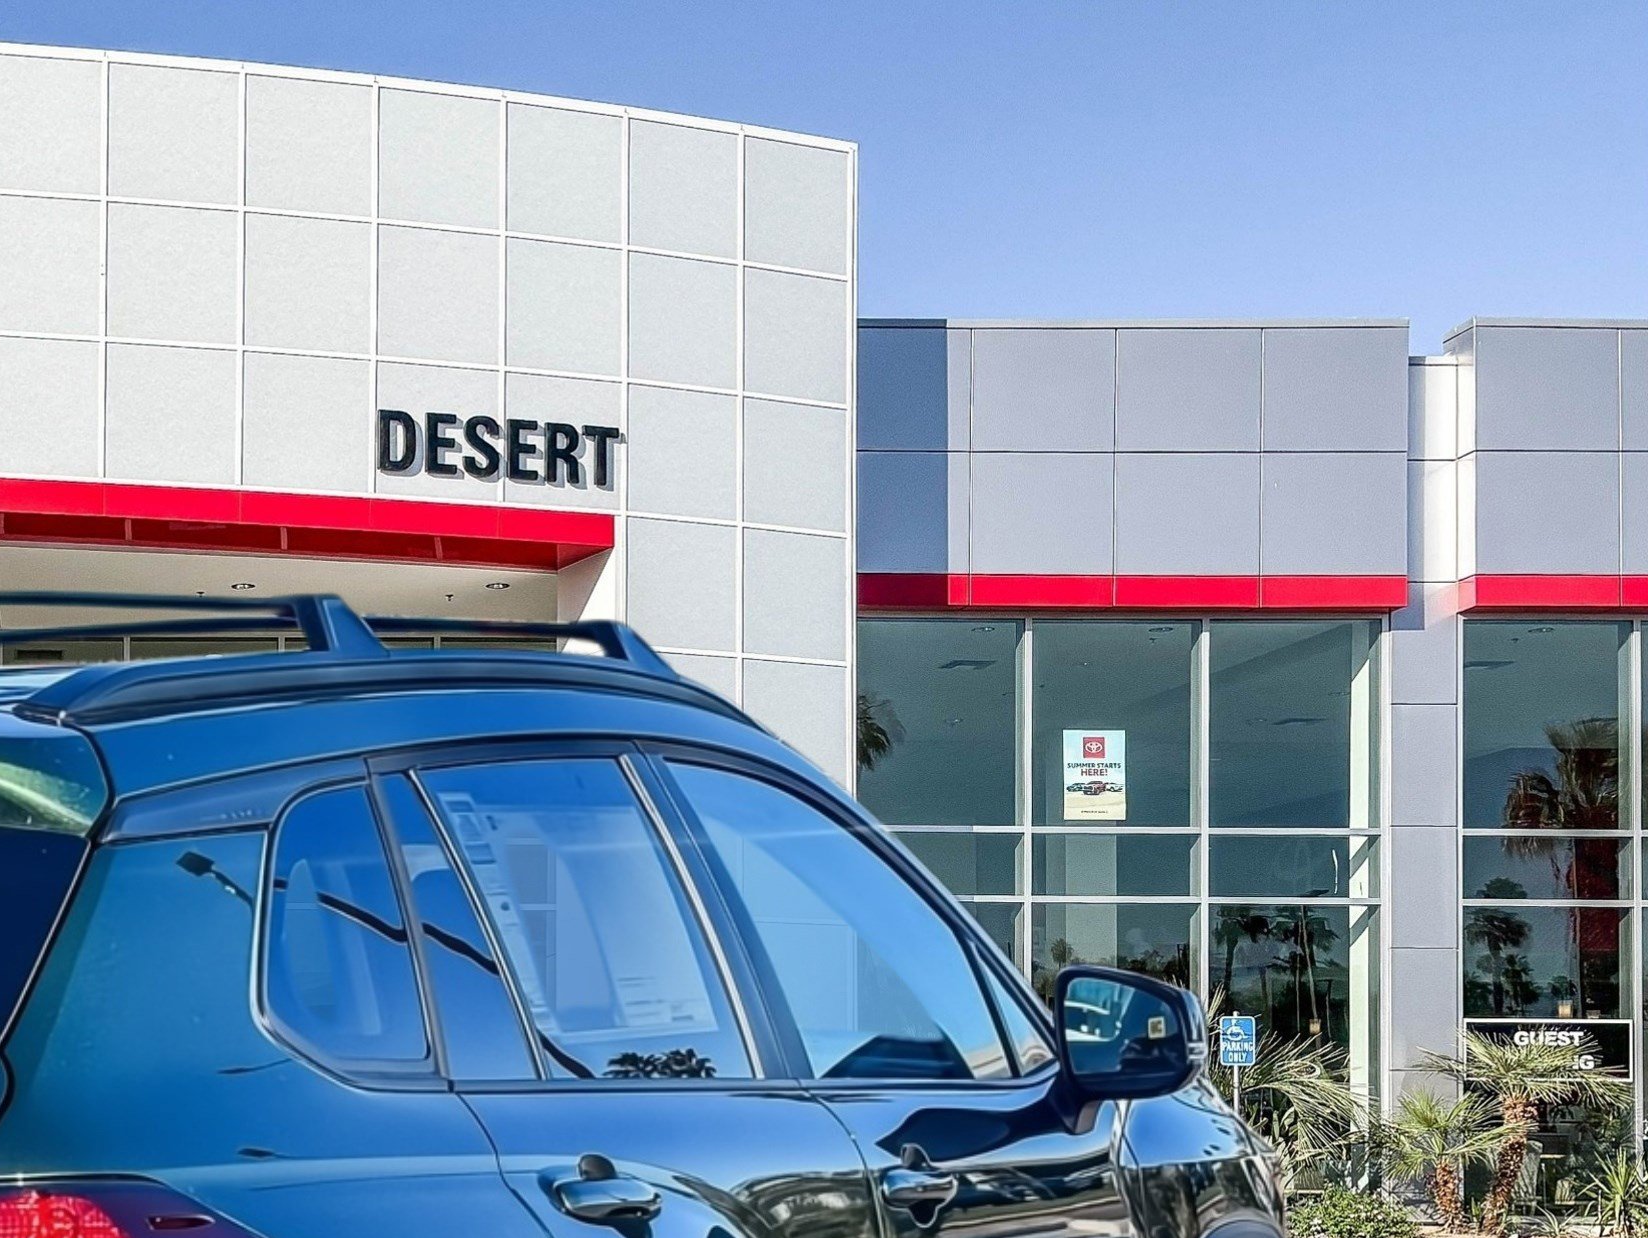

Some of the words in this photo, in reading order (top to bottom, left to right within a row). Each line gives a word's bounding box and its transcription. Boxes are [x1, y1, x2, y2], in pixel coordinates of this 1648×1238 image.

[377, 409, 620, 486] DESERT
[1080, 768, 1108, 777] HERE!
[1513, 1030, 1584, 1047] GUEST
[1222, 1041, 1253, 1052] PARKING
[1228, 1051, 1248, 1062] ONLY
